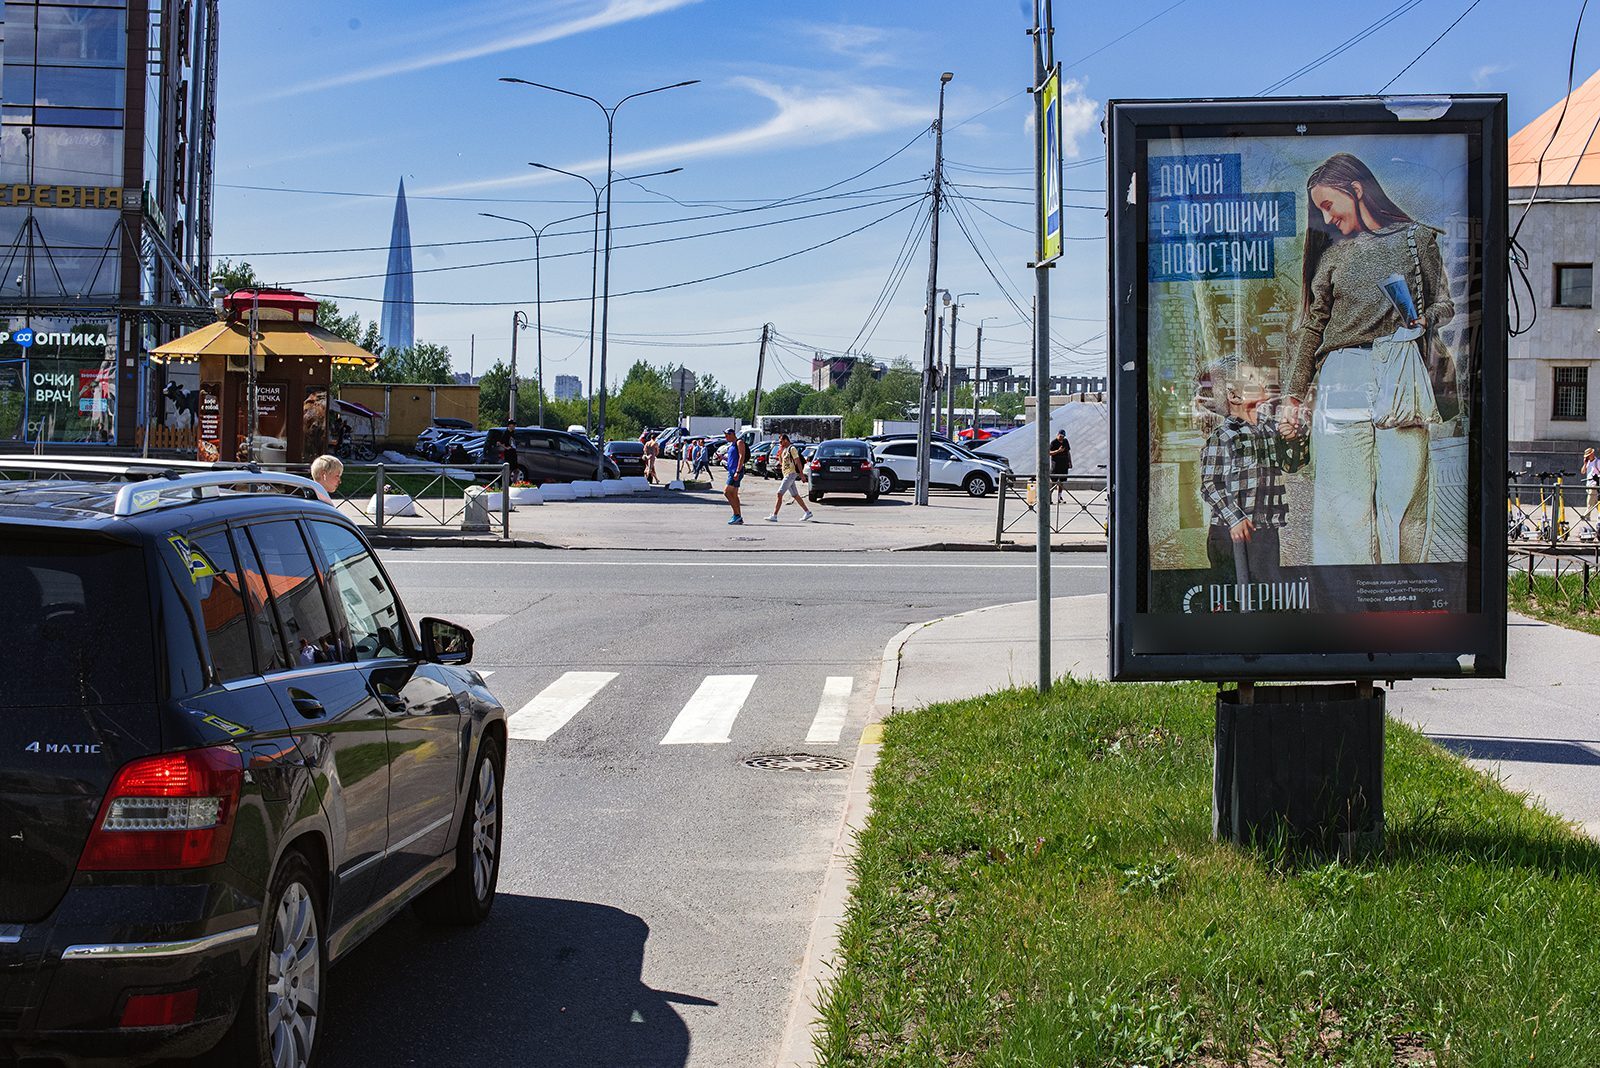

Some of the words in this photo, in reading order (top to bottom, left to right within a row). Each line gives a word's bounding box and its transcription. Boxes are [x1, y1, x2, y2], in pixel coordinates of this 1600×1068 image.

[1160, 158, 1223, 197] ДОМОЙ
[1161, 205, 1170, 235] С
[1179, 200, 1279, 234] ХОРОШИМИ
[1162, 240, 1269, 275] НОВОСТЯМИ
[35, 332, 107, 346] ОПТИКА
[33, 373, 74, 386] ОЧКИ
[36, 389, 71, 402] ВРАЧ
[1210, 577, 1310, 612] ВЕЧЕРНИЙ
[1432, 600, 1449, 608] 16+
